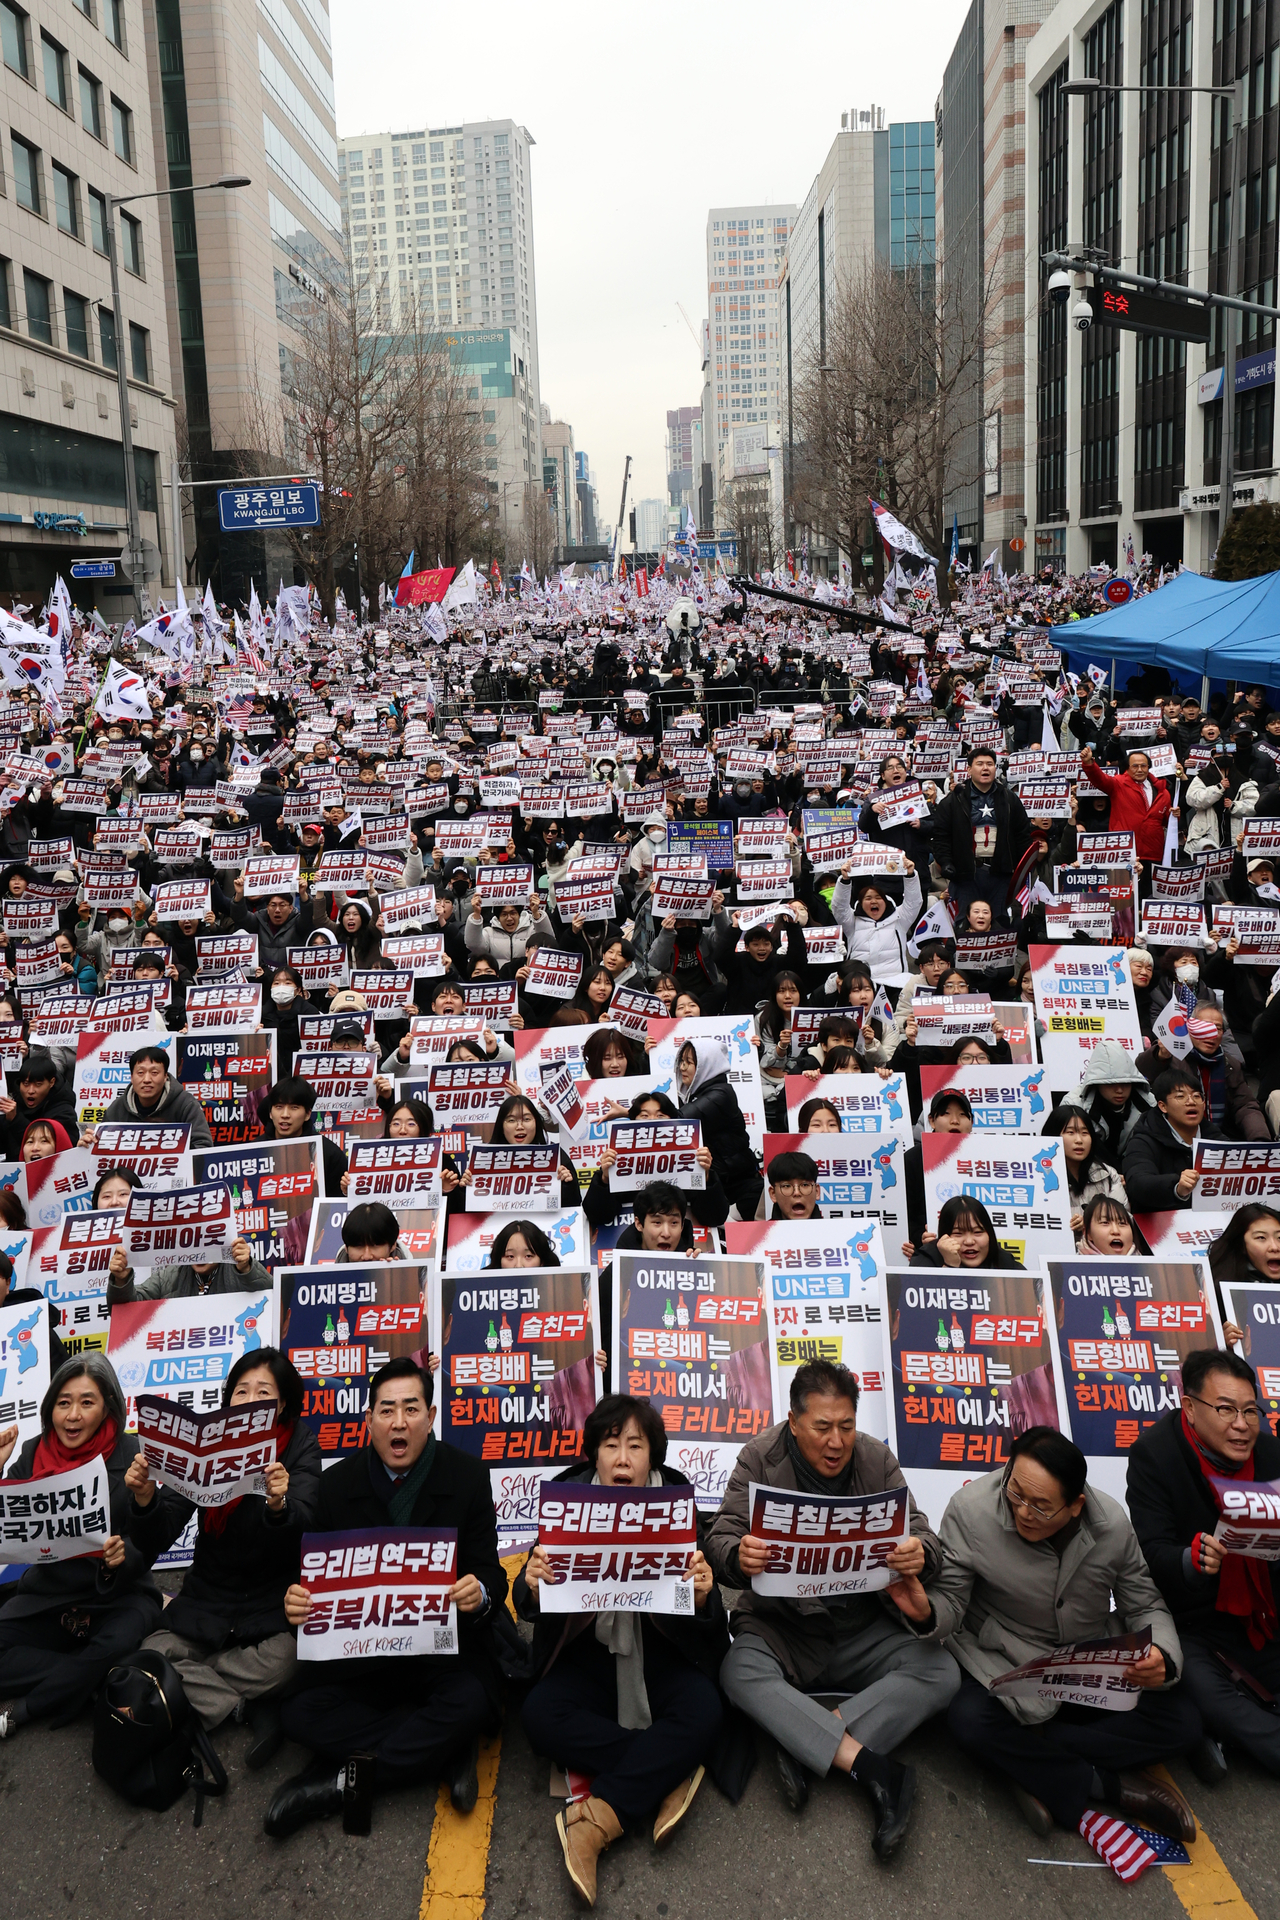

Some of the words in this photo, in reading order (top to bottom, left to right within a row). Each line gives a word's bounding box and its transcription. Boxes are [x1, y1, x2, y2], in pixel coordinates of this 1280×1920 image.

[461, 336, 475, 344] KB
[476, 333, 504, 343] 국민은행
[234, 490, 303, 509] 광주일보
[234, 509, 279, 518] KWANGJU
[283, 507, 304, 515] ILBO
[67, 781, 106, 796] 북침주장
[482, 788, 518, 797] 반국가세력
[484, 780, 517, 789] 척결하자!
[567, 785, 607, 798] 북침주장
[1022, 785, 1067, 797] 북침주장
[64, 794, 104, 808] 형배아웃
[569, 797, 609, 810] 형배아웃
[1022, 799, 1067, 810] 형배아웃
[437, 824, 486, 836] 북침주장
[742, 820, 787, 834] 북침주장
[439, 838, 483, 849] 형배아웃
[741, 835, 785, 847] 형배아웃
[1082, 834, 1131, 849] 북침주장
[247, 857, 298, 873] 북침주장
[1081, 851, 1132, 864] 형배아웃
[247, 873, 295, 888] 형배아웃
[481, 868, 529, 882] 북침주장
[1067, 874, 1108, 885] 이재명과
[157, 883, 208, 898] 북침주장
[480, 885, 529, 898] 형배아웃
[555, 885, 582, 898] 우리법
[583, 879, 613, 894] 연구회
[157, 898, 207, 913] 형배아웃
[559, 898, 612, 917] 종북사조직
[1070, 902, 1109, 912] 국회권한?
[1145, 905, 1200, 920] 북침주장
[1092, 919, 1110, 928] 권한!
[1147, 921, 1201, 936] 형배아웃
[383, 938, 442, 954] 북침주장
[957, 936, 987, 947] 우리법
[988, 932, 1017, 945] 연구회
[957, 950, 1014, 963] 종북사조직
[1054, 963, 1108, 977] 북침통일!
[354, 973, 411, 991] 북침주장
[1061, 980, 1106, 993] UN군을
[191, 987, 260, 1008] 북침주장
[1042, 997, 1077, 1008] 침략자
[1081, 997, 1092, 1008] 로
[1096, 998, 1130, 1009] 부르는
[39, 998, 90, 1018] 북침주장
[943, 1002, 992, 1015] 국회권한?
[190, 1009, 258, 1027] 형배아웃
[916, 1015, 943, 1030] 계엄은
[942, 1023, 970, 1035] 대통령
[971, 1020, 993, 1033] 권한!
[1052, 1016, 1103, 1032] 문형배는
[186, 1042, 239, 1057] 이재명과
[227, 1058, 268, 1073] 술친구
[298, 1058, 372, 1076] 북침주장
[431, 1066, 506, 1087] 북침주장
[434, 1090, 505, 1111] 형배아웃
[96, 1128, 184, 1151] 북침주장
[614, 1124, 696, 1149] 북침주장
[96, 1156, 180, 1177] 형배아웃
[354, 1146, 436, 1168] 북침주장
[473, 1148, 553, 1171] 북침주장
[616, 1152, 696, 1177] 형배아웃
[207, 1158, 276, 1180] 이재명과
[956, 1159, 1034, 1180] 북침통일!
[261, 1173, 313, 1197] 술친구
[354, 1173, 433, 1196] 형배아웃
[473, 1175, 552, 1197] 형배아웃
[129, 1188, 225, 1222] 북침주장
[492, 1200, 511, 1210] SAVE
[512, 1199, 535, 1209] KOREA
[965, 1186, 1029, 1205] UN군을
[1013, 1212, 1063, 1230] 부르는
[130, 1223, 226, 1252] 형배아웃
[155, 1255, 177, 1266] SAVE
[177, 1253, 206, 1263] KOREA
[764, 1248, 849, 1268] 북침통일!
[636, 1269, 716, 1293] 이재명과
[775, 1277, 845, 1297] UN군을
[1067, 1275, 1154, 1298] 이재명과
[297, 1282, 378, 1306] 이재명과
[458, 1287, 541, 1312] 이재명과
[904, 1287, 991, 1312] 이재명과
[697, 1297, 760, 1322] 술친구
[805, 1309, 822, 1322] 로
[829, 1307, 881, 1324] 부르는
[1138, 1304, 1204, 1328] 술친구
[358, 1308, 421, 1333] 술친구
[521, 1315, 585, 1340] 술친구
[145, 1325, 234, 1352] 북침통일!
[974, 1318, 1040, 1344] 술친구
[151, 1357, 224, 1383] UN군을
[627, 1370, 727, 1400] 헌재에서
[1072, 1385, 1183, 1412] 헌재에서
[450, 1397, 551, 1425] 헌재에서
[661, 1405, 770, 1435] 물러나라!
[902, 1395, 1011, 1428] 헌재에서
[137, 1405, 199, 1443] 우리법
[200, 1408, 275, 1447] 연구회
[481, 1429, 585, 1460] 물러나라
[142, 1443, 274, 1488] 종북사조직
[678, 1448, 721, 1471] SAVE
[174, 1482, 202, 1502] SAVE
[197, 1487, 234, 1505] KOREA
[501, 1472, 542, 1498] SAVE
[539, 1502, 618, 1534] 우리법
[618, 1498, 694, 1532] 연구회
[761, 1499, 899, 1537] 북침주장
[301, 1544, 379, 1583] 우리법
[381, 1541, 456, 1576] 연구회
[766, 1541, 899, 1575] 형배아웃
[544, 1550, 694, 1586] 종북사조직
[796, 1582, 826, 1597] SAVE
[828, 1577, 868, 1593] KOREA
[580, 1592, 610, 1610] SAVE
[613, 1589, 654, 1607] KOREA
[301, 1593, 453, 1637] 종북사조직
[342, 1638, 373, 1655] SAVE
[375, 1636, 413, 1653] KOREA
[1041, 1673, 1103, 1688] 대통령
[1037, 1688, 1067, 1700] SAVE
[1069, 1691, 1108, 1707] KOREA
